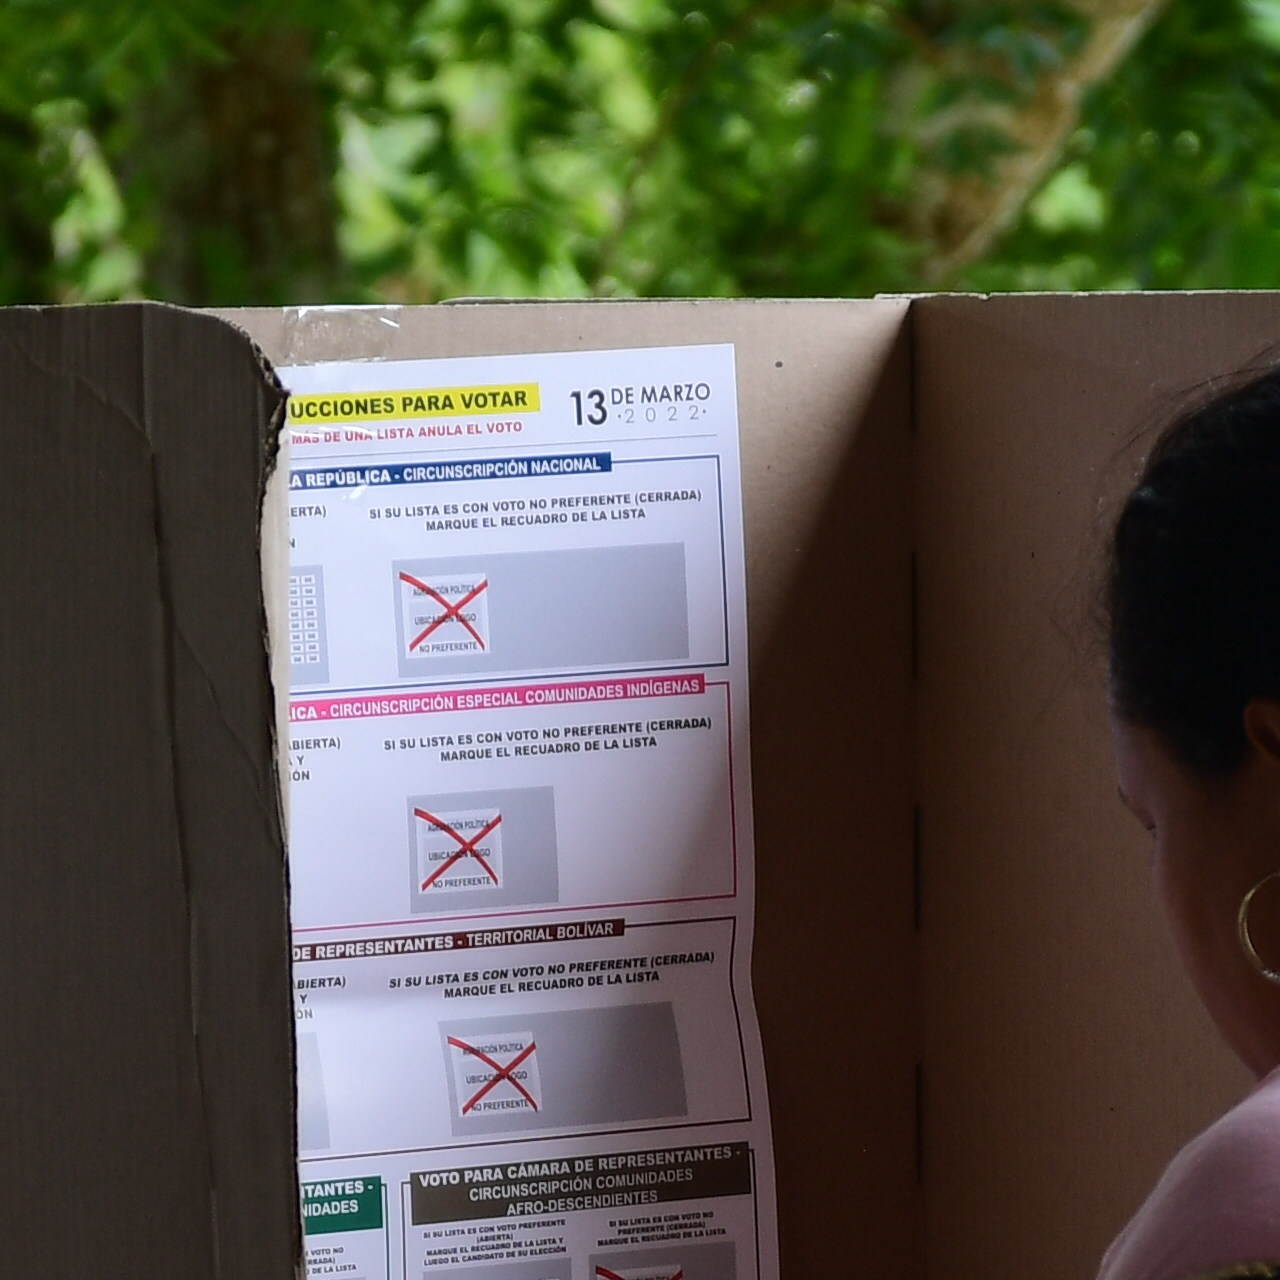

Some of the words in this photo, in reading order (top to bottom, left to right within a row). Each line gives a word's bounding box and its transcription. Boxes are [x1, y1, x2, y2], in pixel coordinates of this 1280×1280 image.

[291, 398, 394, 417] UCCIONES
[402, 394, 454, 411] PARA
[461, 390, 527, 408] VOTAR
[570, 389, 607, 425] 13
[611, 387, 634, 405] DE
[641, 383, 710, 403] MARZO
[324, 432, 340, 442] DE
[377, 428, 413, 439] LISTA
[419, 426, 462, 437] ANULA
[467, 425, 482, 434] EL
[487, 422, 522, 433] VOTO
[307, 469, 391, 486] REPÚBLICA
[404, 459, 527, 480] CIRCUNSCRIPCIÓN
[531, 457, 601, 474] NACIONAL
[370, 509, 381, 519] SI
[385, 507, 401, 518] SU
[405, 505, 439, 516] LISTA
[444, 503, 458, 514] ES
[463, 502, 488, 513] CON
[493, 501, 525, 511] VOTO
[530, 499, 546, 509] NO
[551, 494, 630, 508] PREFERENTE
[635, 489, 701, 506] (CERRADA)
[426, 516, 478, 531] MARQUE
[483, 515, 497, 527] EL
[501, 513, 568, 526] RECUADRO
[572, 512, 587, 522] DE
[592, 511, 607, 520] LA
[611, 508, 645, 519] LISTA
[432, 642, 476, 652] PREFERENTE
[289, 706, 317, 719] ICA
[330, 695, 453, 717] CIRCUNSCRIPCIÓN
[457, 691, 521, 708] ESPECIAL
[525, 685, 623, 703] COMUNIDADES
[628, 679, 699, 696] INDÍGENAS
[384, 740, 395, 750] SI
[400, 739, 415, 748] SU
[420, 737, 454, 747] LISTA
[458, 735, 472, 745] ES
[477, 733, 502, 744] CON
[506, 730, 538, 741] VOTO
[543, 729, 559, 739] NO
[564, 722, 642, 737] PREFERENTE
[646, 717, 711, 734] (CERRADA)
[441, 749, 492, 761] MARQUE
[497, 747, 510, 756] EL
[515, 742, 580, 756] RECUADRO
[585, 741, 600, 751] DE
[604, 739, 619, 749] LA
[623, 737, 657, 748] LISTA
[445, 876, 490, 887] PREFERENTE
[293, 946, 311, 960] DE
[316, 936, 453, 958] REPRESENTANTES
[466, 928, 553, 946] TERRITORIAL
[557, 921, 613, 939] BOLÍVAR
[294, 977, 346, 989] BIERTA)
[389, 979, 401, 988] SI
[405, 977, 422, 987] SU
[425, 974, 459, 985] LISTA
[464, 972, 478, 982] ES
[483, 970, 508, 981] CON
[513, 966, 544, 977] VOTO
[548, 964, 565, 976] NO
[570, 957, 647, 973] PREFERENTE
[651, 952, 714, 969] (CERRADA)
[444, 984, 495, 999] MARQUE
[500, 983, 514, 993] EL
[519, 978, 584, 992] RECUADRO
[588, 976, 603, 986] DE
[607, 974, 622, 984] LA
[626, 972, 659, 983] LISTA
[484, 1099, 528, 1110] PREFERENTE
[420, 1172, 460, 1187] VOTO
[464, 1168, 503, 1183] PARA
[508, 1159, 570, 1179] CÁMARA
[575, 1159, 593, 1172] DE
[599, 1146, 731, 1170] REPRESENTANTES
[470, 1177, 592, 1201] CIRCUNSCRIPCIÓN
[596, 1168, 693, 1189] COMUNIDADES
[507, 1190, 658, 1215] AFRO-DESCENDIENTES
[479, 1226, 494, 1234] CON
[497, 1224, 516, 1232] VOTO
